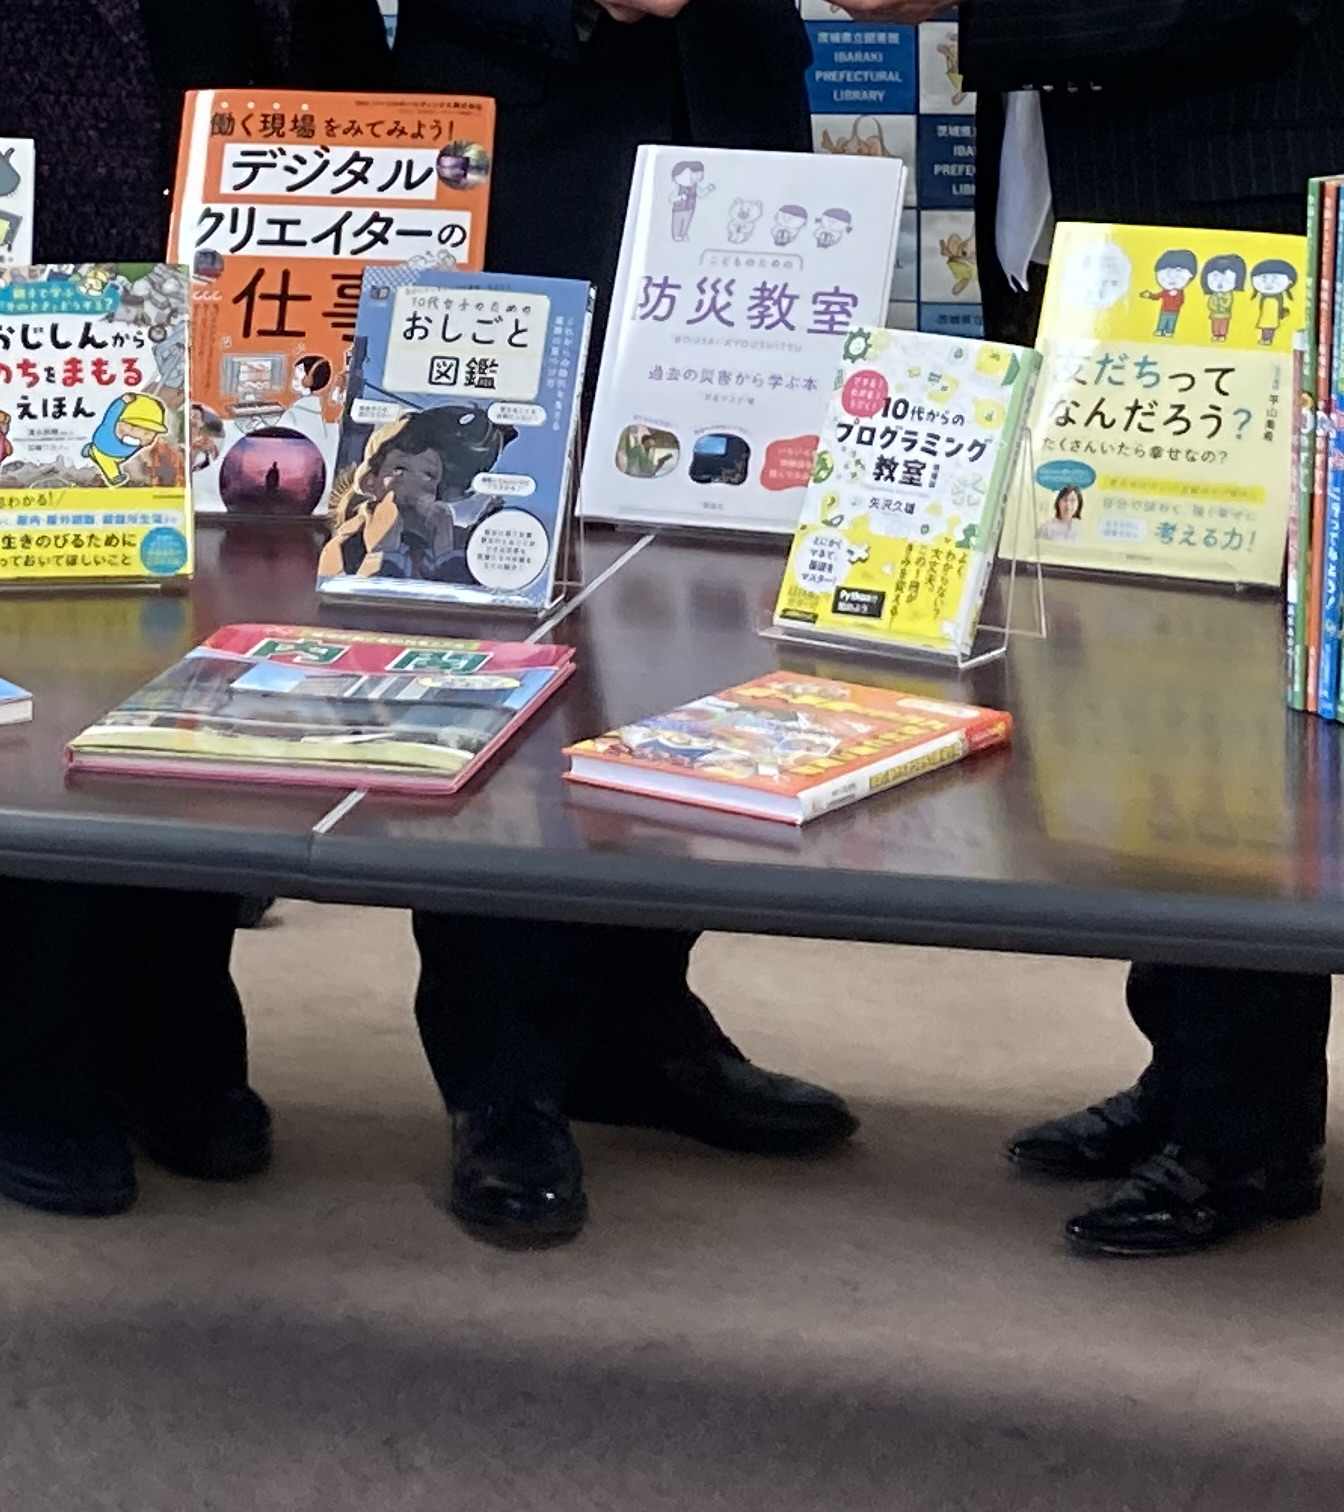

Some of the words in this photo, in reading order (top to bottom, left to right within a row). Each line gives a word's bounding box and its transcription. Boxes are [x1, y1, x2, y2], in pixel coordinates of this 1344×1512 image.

[819, 32, 899, 44] 茨城県立図書館
[835, 51, 883, 62] IBARAKI
[816, 70, 903, 83] PREFECTURAL
[834, 90, 885, 101] LIBRARY
[211, 112, 454, 140] 働く現場をみてみよう！
[233, 145, 433, 194] デジタル
[195, 207, 467, 255] クリエイターの
[710, 258, 793, 270] こどものための
[411, 296, 530, 315] 10代女子のための
[636, 276, 858, 336] 防災教室
[404, 312, 528, 347] おしごと
[429, 356, 498, 389] 図鑑
[648, 365, 818, 391] 過去の災害から学ぶ本
[1056, 353, 1235, 396] 友だちって
[17, 396, 95, 420] えほん
[881, 398, 965, 426] 10代からの
[1051, 397, 1252, 439] なんだろう？
[836, 418, 993, 462] プログラミング
[1043, 437, 1227, 463] たくさんいたら幸せなの？
[873, 453, 926, 487] 教室
[1157, 521, 1256, 552] 考える力！
